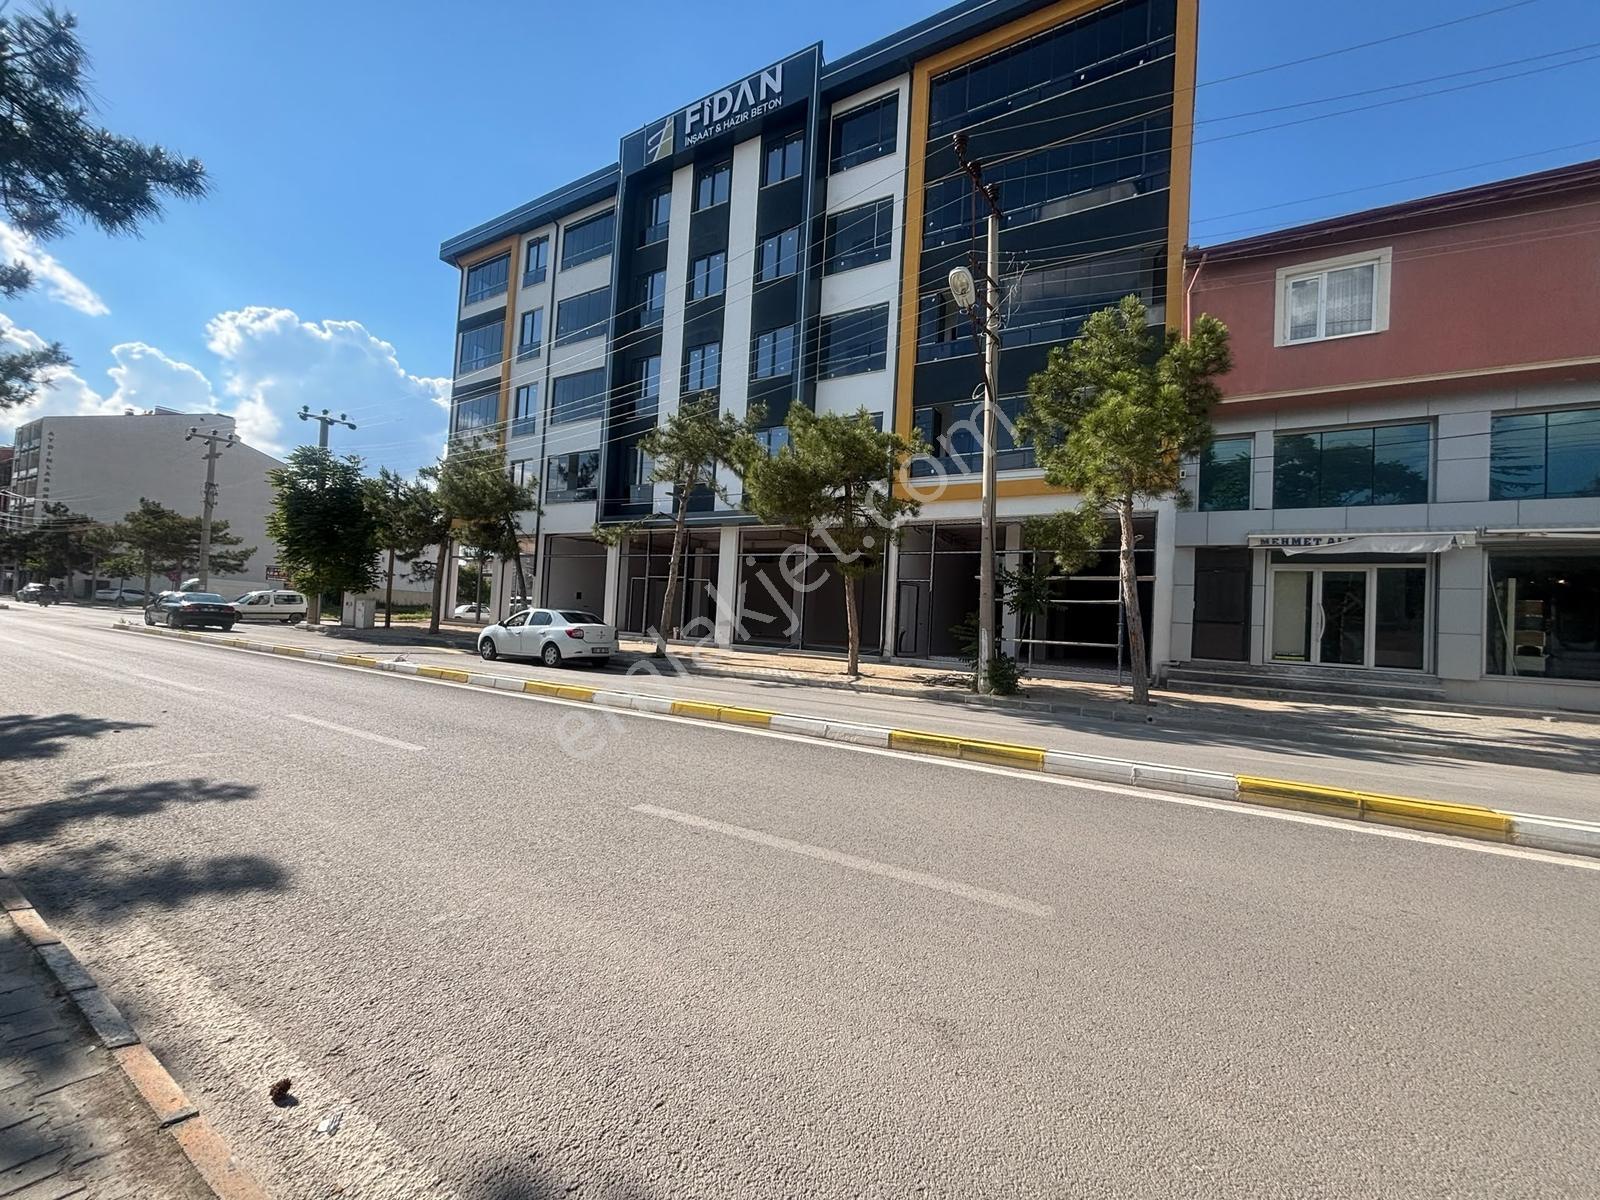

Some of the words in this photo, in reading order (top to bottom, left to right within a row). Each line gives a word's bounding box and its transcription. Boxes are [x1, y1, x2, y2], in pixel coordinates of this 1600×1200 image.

[715, 123, 722, 133] &
[723, 111, 749, 130] HAZIR
[751, 96, 782, 118] BETON
[1260, 537, 1323, 546] MEHMET
